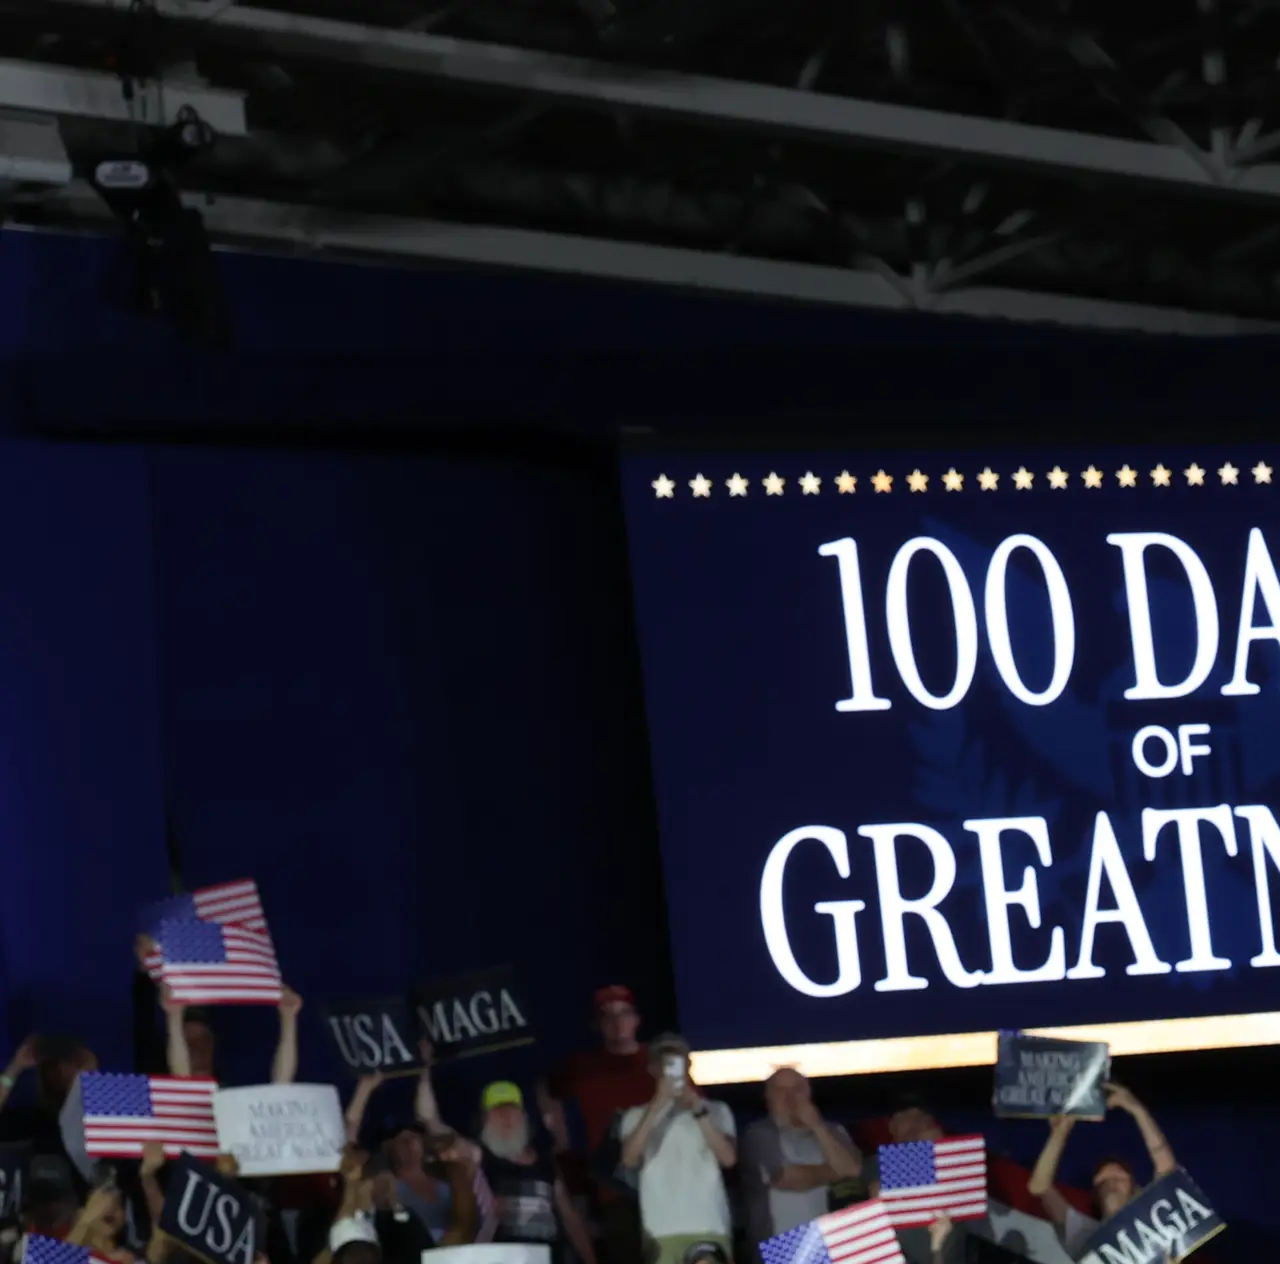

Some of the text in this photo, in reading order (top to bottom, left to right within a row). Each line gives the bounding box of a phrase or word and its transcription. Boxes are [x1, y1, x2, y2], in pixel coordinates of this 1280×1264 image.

[818, 534, 1075, 712] 100
[1132, 724, 1211, 778] OF
[329, 1014, 414, 1068] USA
[416, 988, 527, 1043] MAGA
